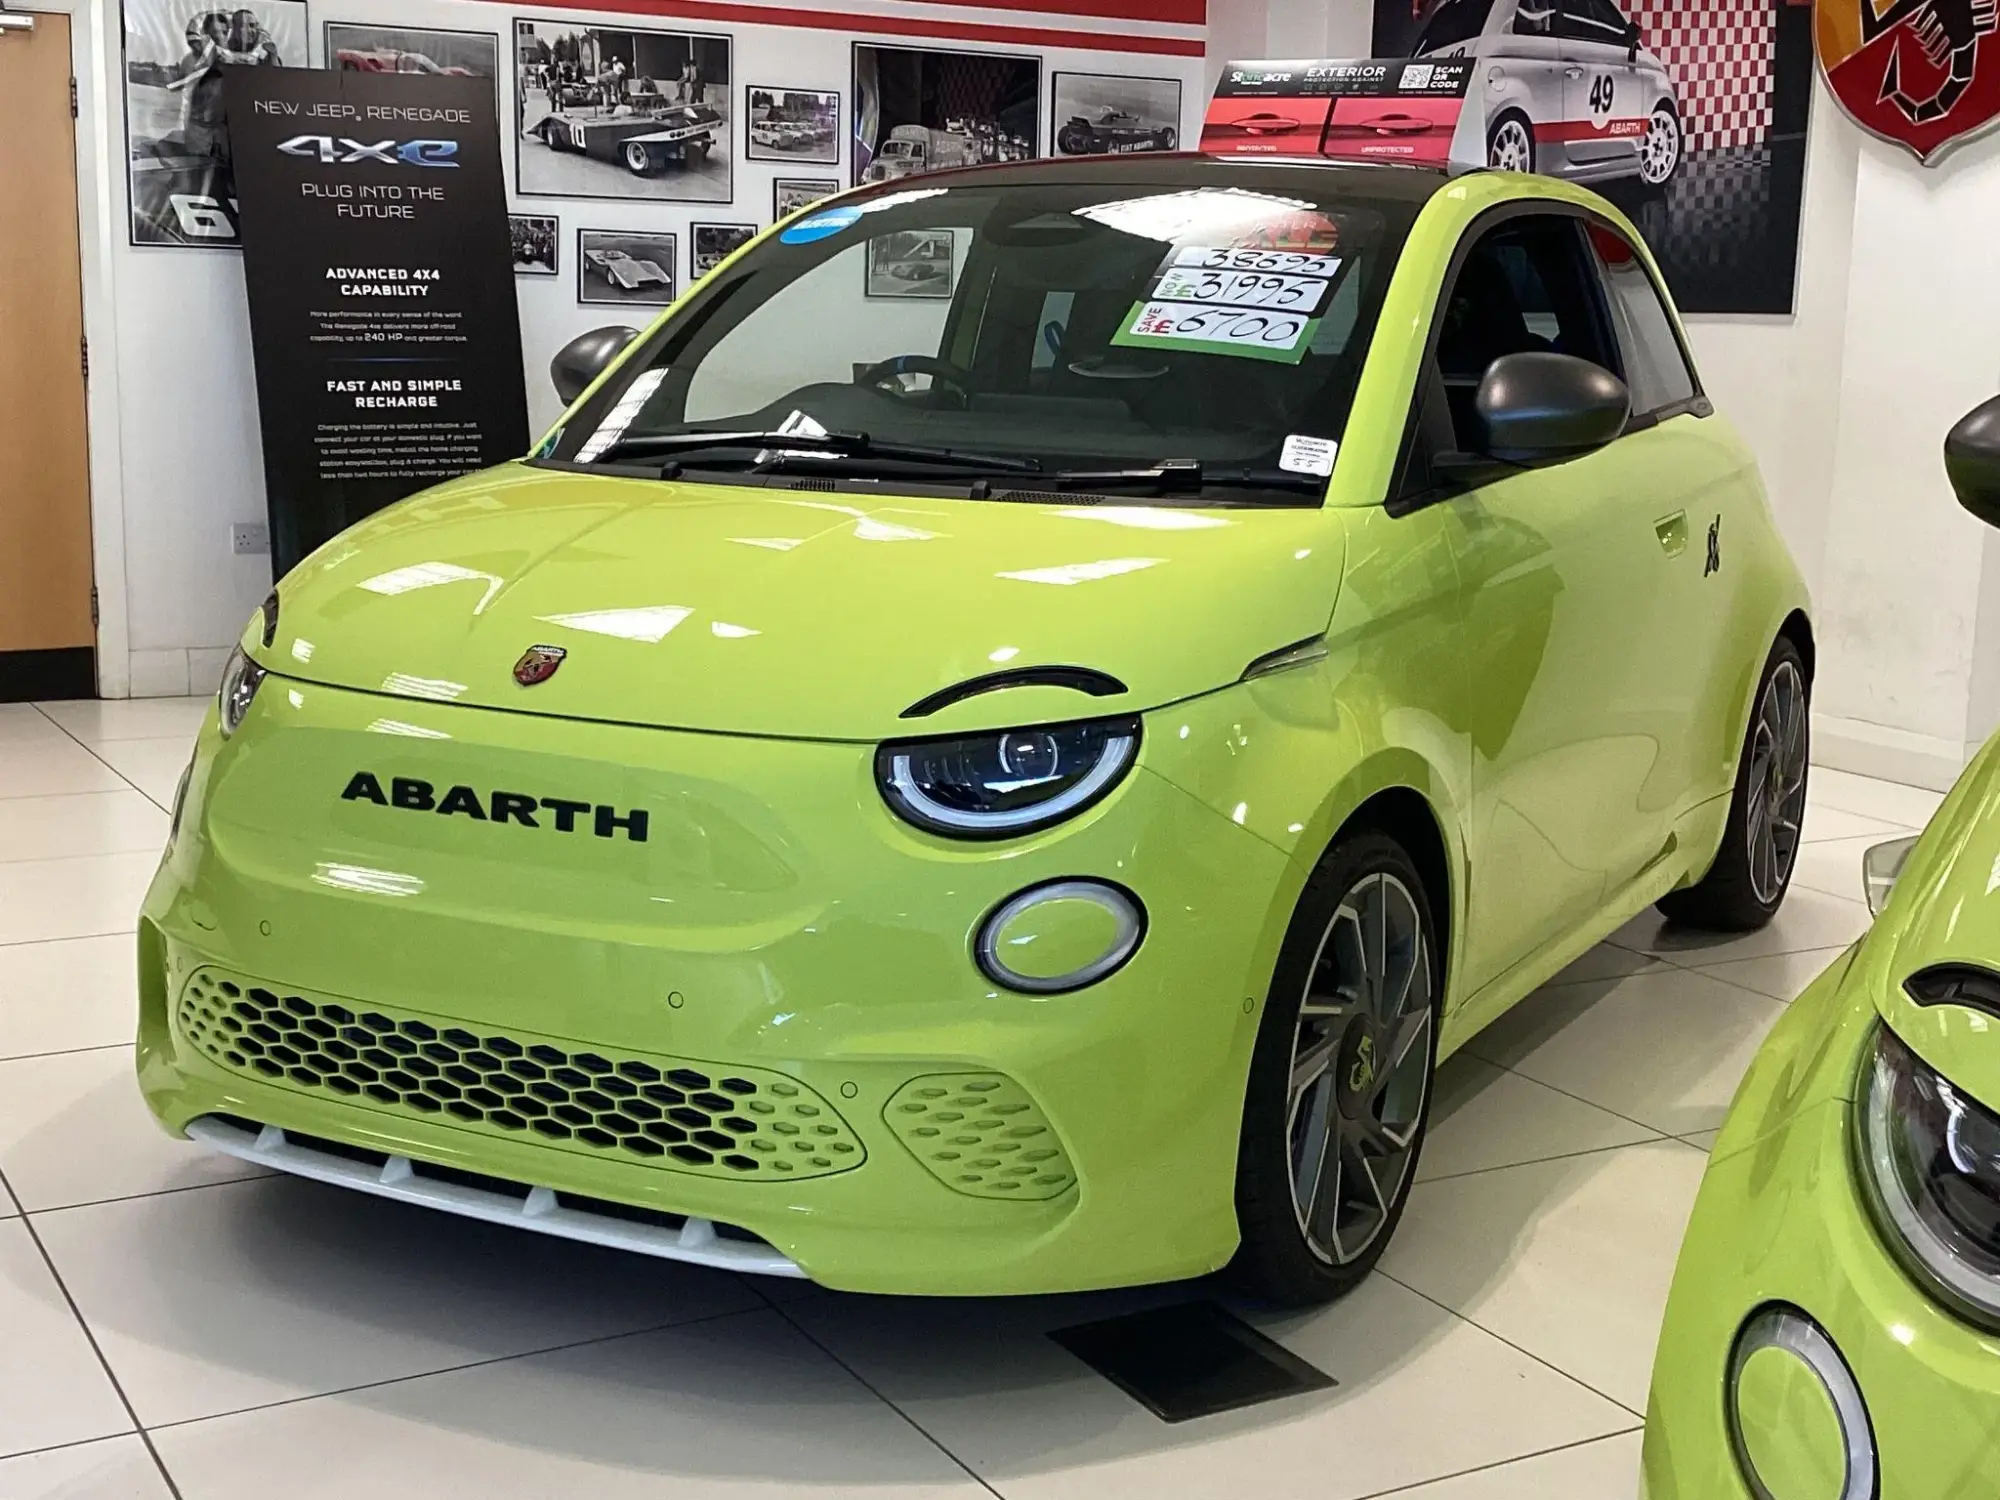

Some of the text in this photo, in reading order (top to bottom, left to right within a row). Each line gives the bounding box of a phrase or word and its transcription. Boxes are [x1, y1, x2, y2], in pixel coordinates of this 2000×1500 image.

[1306, 66, 1387, 77] EXTERIOR
[1435, 66, 1463, 74] SCAN
[1430, 81, 1459, 89] CODE
[1589, 74, 1614, 114] 49
[254, 100, 300, 115] NEW
[367, 106, 472, 123] RENEGADE
[1609, 122, 1641, 135] ABARTH
[569, 123, 586, 149] 10
[301, 183, 445, 200] PLUG INTO THE
[337, 204, 415, 219] FUTURE
[1202, 248, 1342, 272] 38695
[325, 268, 441, 280] ADVANCED 4X4
[341, 284, 429, 296] CAPABILITY
[1137, 307, 1163, 333] SAVE
[364, 332, 385, 342] 240
[387, 332, 403, 341] HP
[327, 379, 462, 392] FAST AND SIMPLE
[355, 396, 438, 408] RECHARGE
[341, 771, 649, 843] ABARTH
